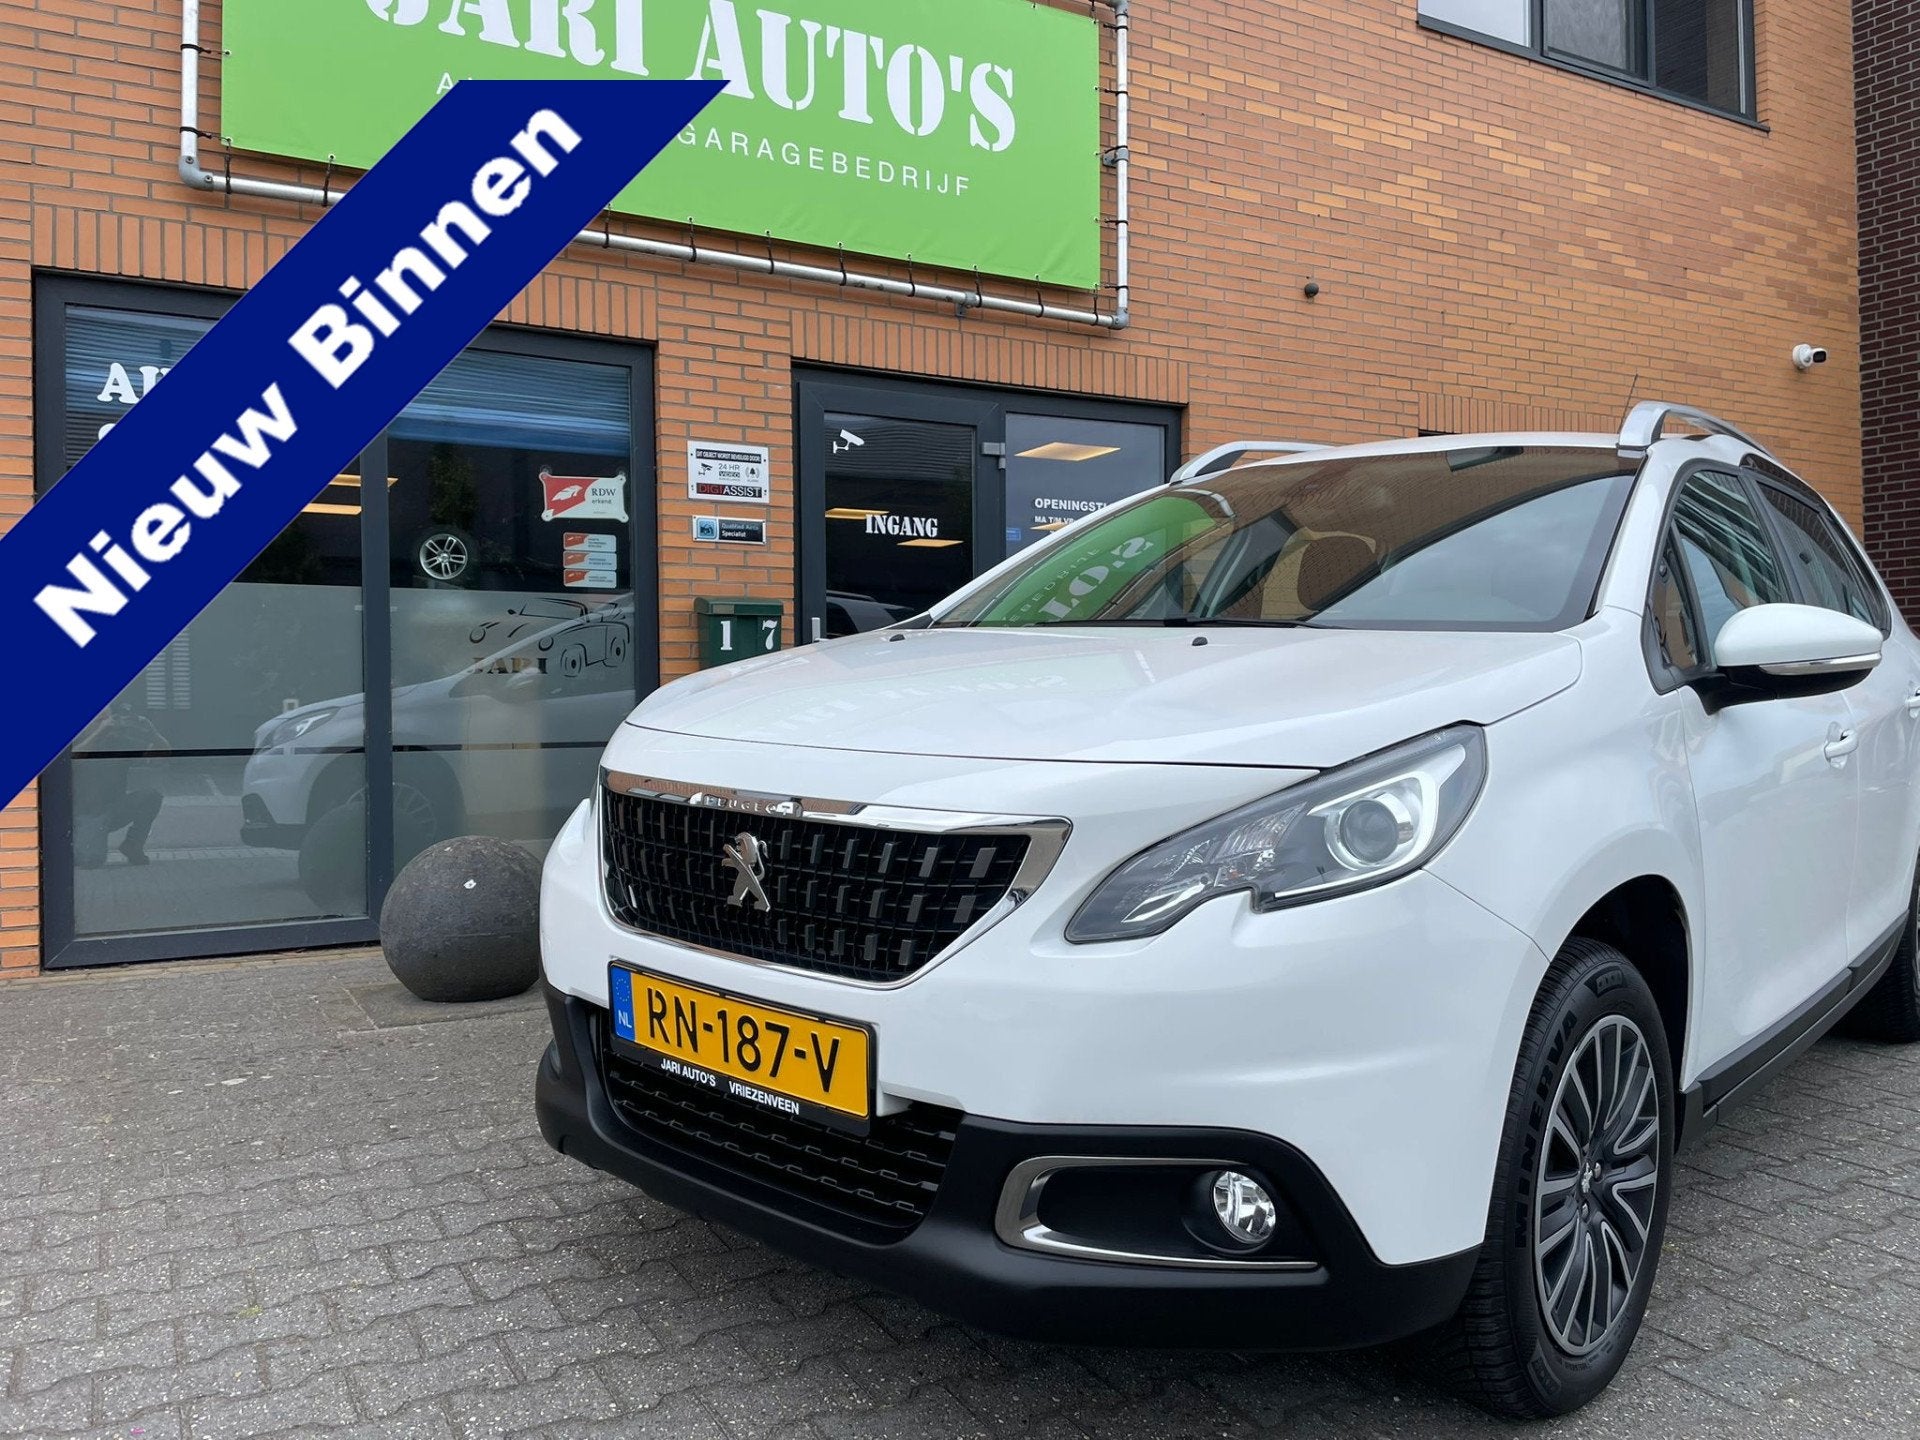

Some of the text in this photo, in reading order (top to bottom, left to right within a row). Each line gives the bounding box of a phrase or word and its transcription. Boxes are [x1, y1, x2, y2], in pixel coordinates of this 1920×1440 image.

[686, 0, 1016, 152] AUTO'S
[677, 123, 970, 197] GARAGEBEDRIJF
[592, 488, 616, 496] RDW
[865, 513, 938, 538] INGANG
[720, 620, 778, 650] 1 7
[618, 1010, 632, 1028] NL
[647, 987, 840, 1093] RN-187-V
[660, 1058, 800, 1116] JARI AUTO'S VRIEZENVEEN
